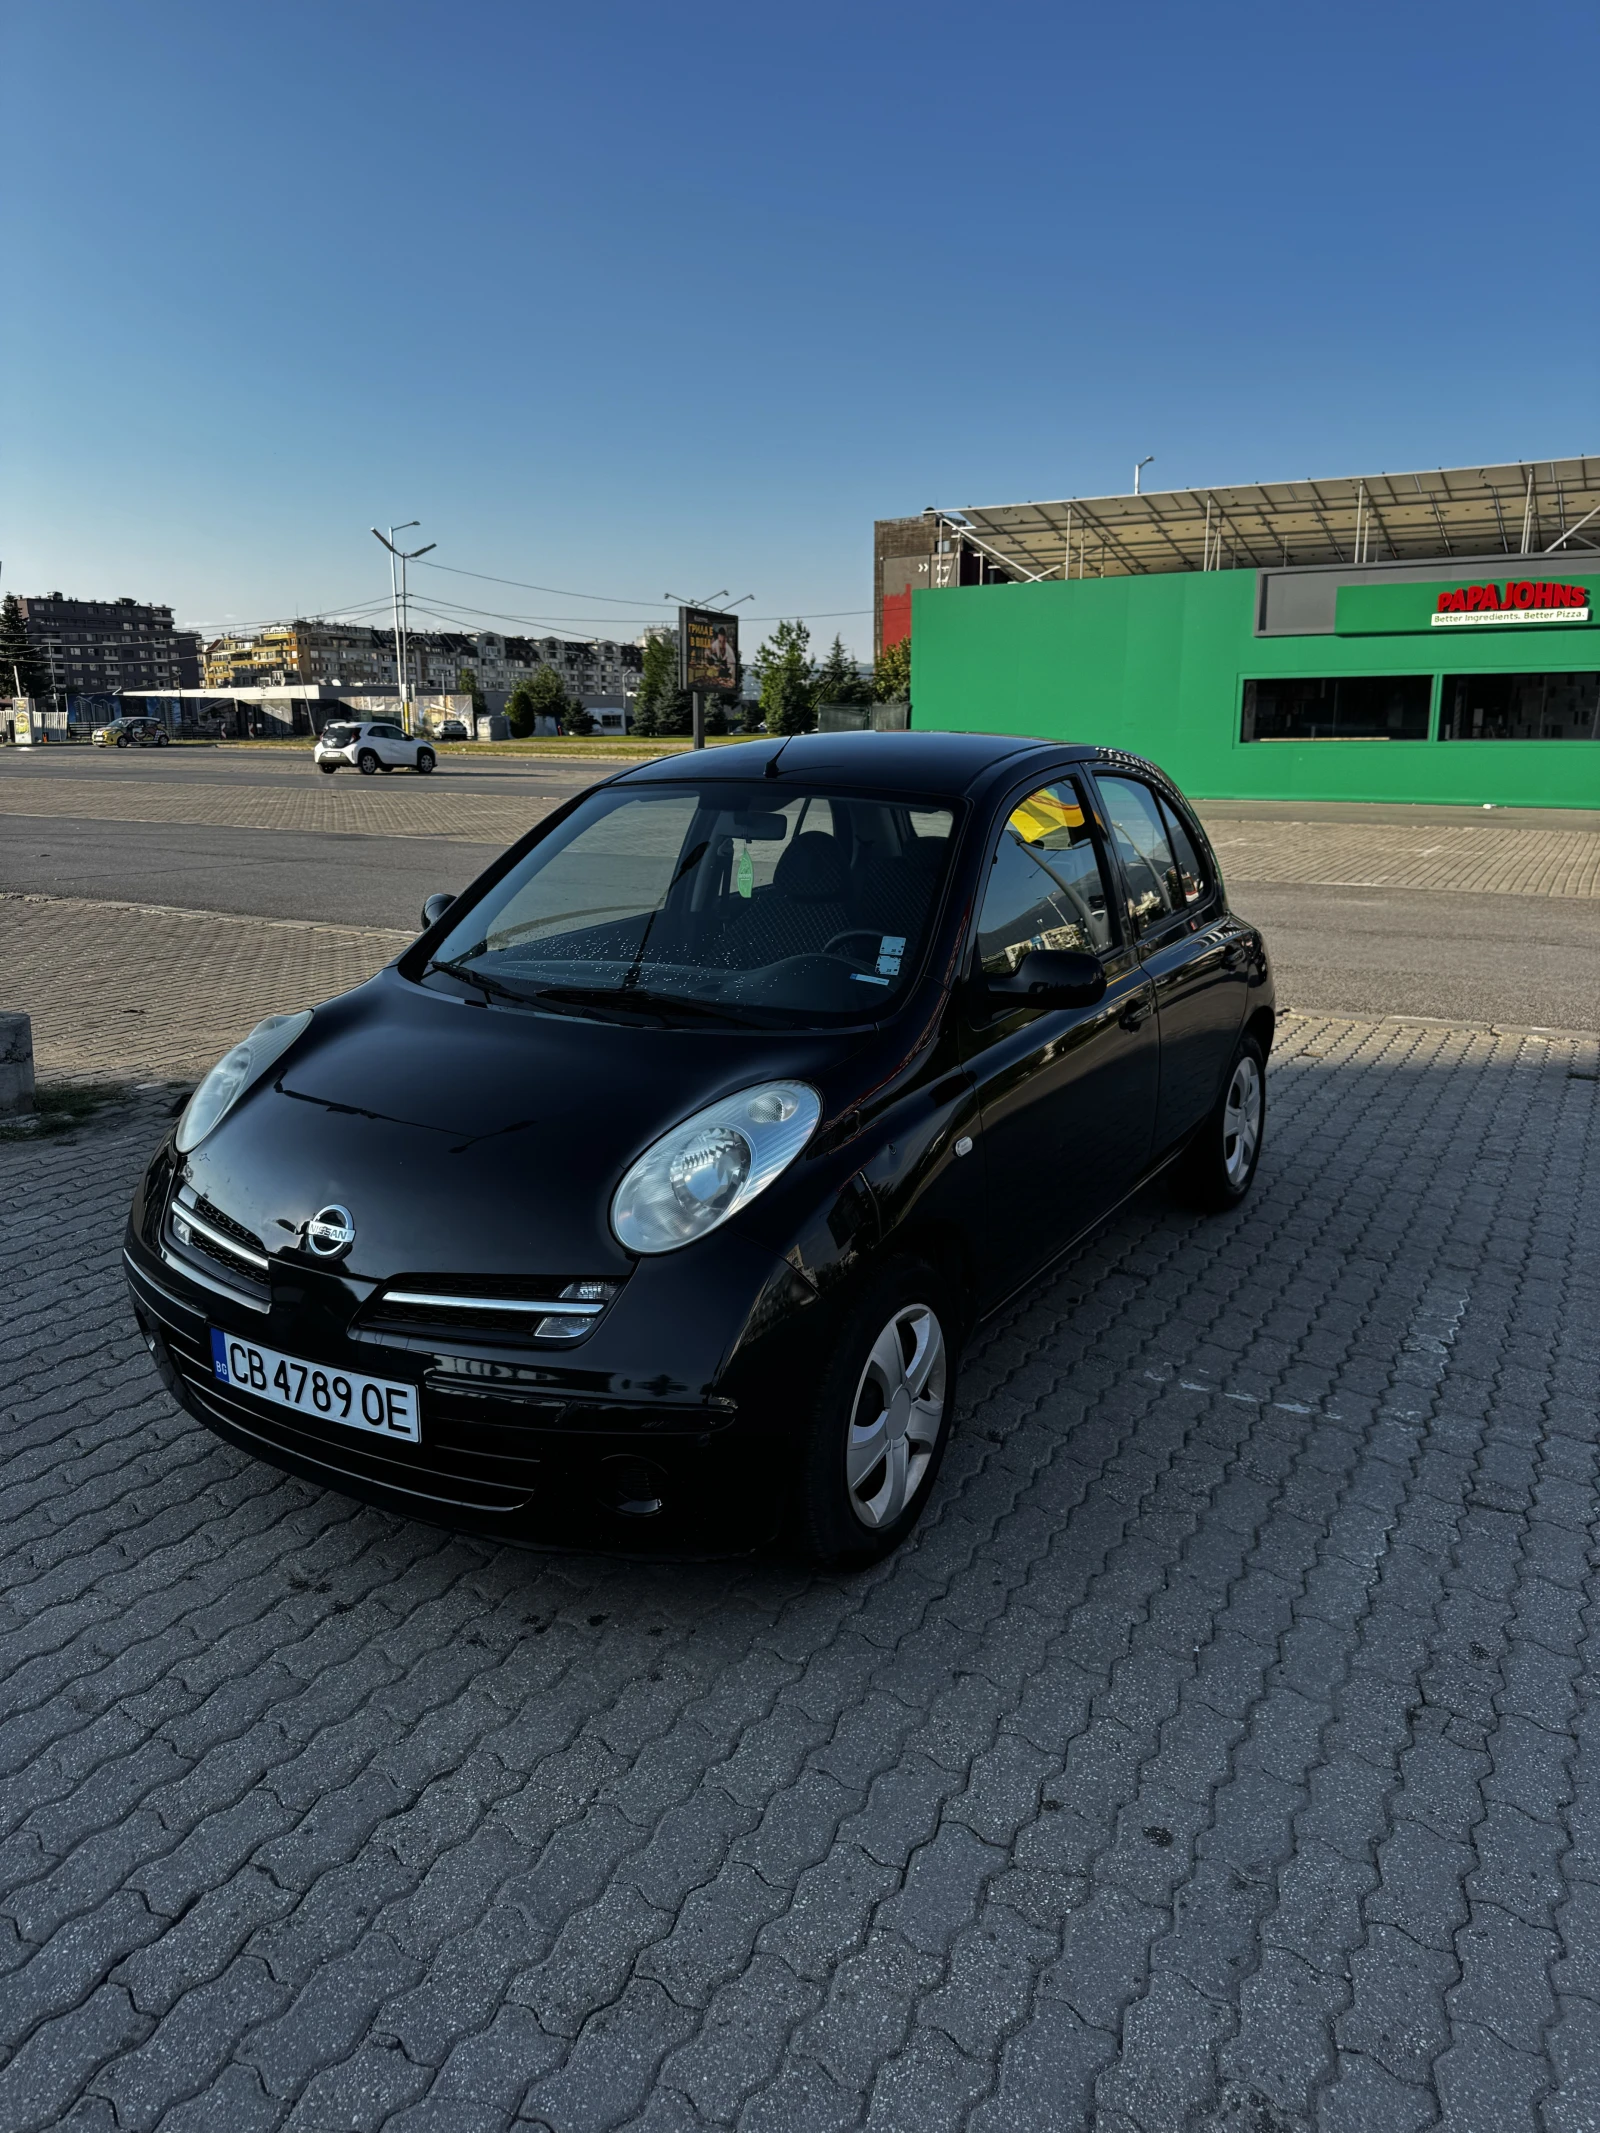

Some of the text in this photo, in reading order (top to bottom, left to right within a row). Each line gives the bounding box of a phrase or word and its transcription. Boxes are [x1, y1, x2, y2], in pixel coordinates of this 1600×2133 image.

[1437, 581, 1585, 612] PAPA JOHNS
[1434, 610, 1585, 624] Better Ingredients. Better Pizza.
[310, 1223, 348, 1240] NISSAN
[216, 1360, 228, 1376] BG
[230, 1342, 411, 1434] CB 4789 OE
